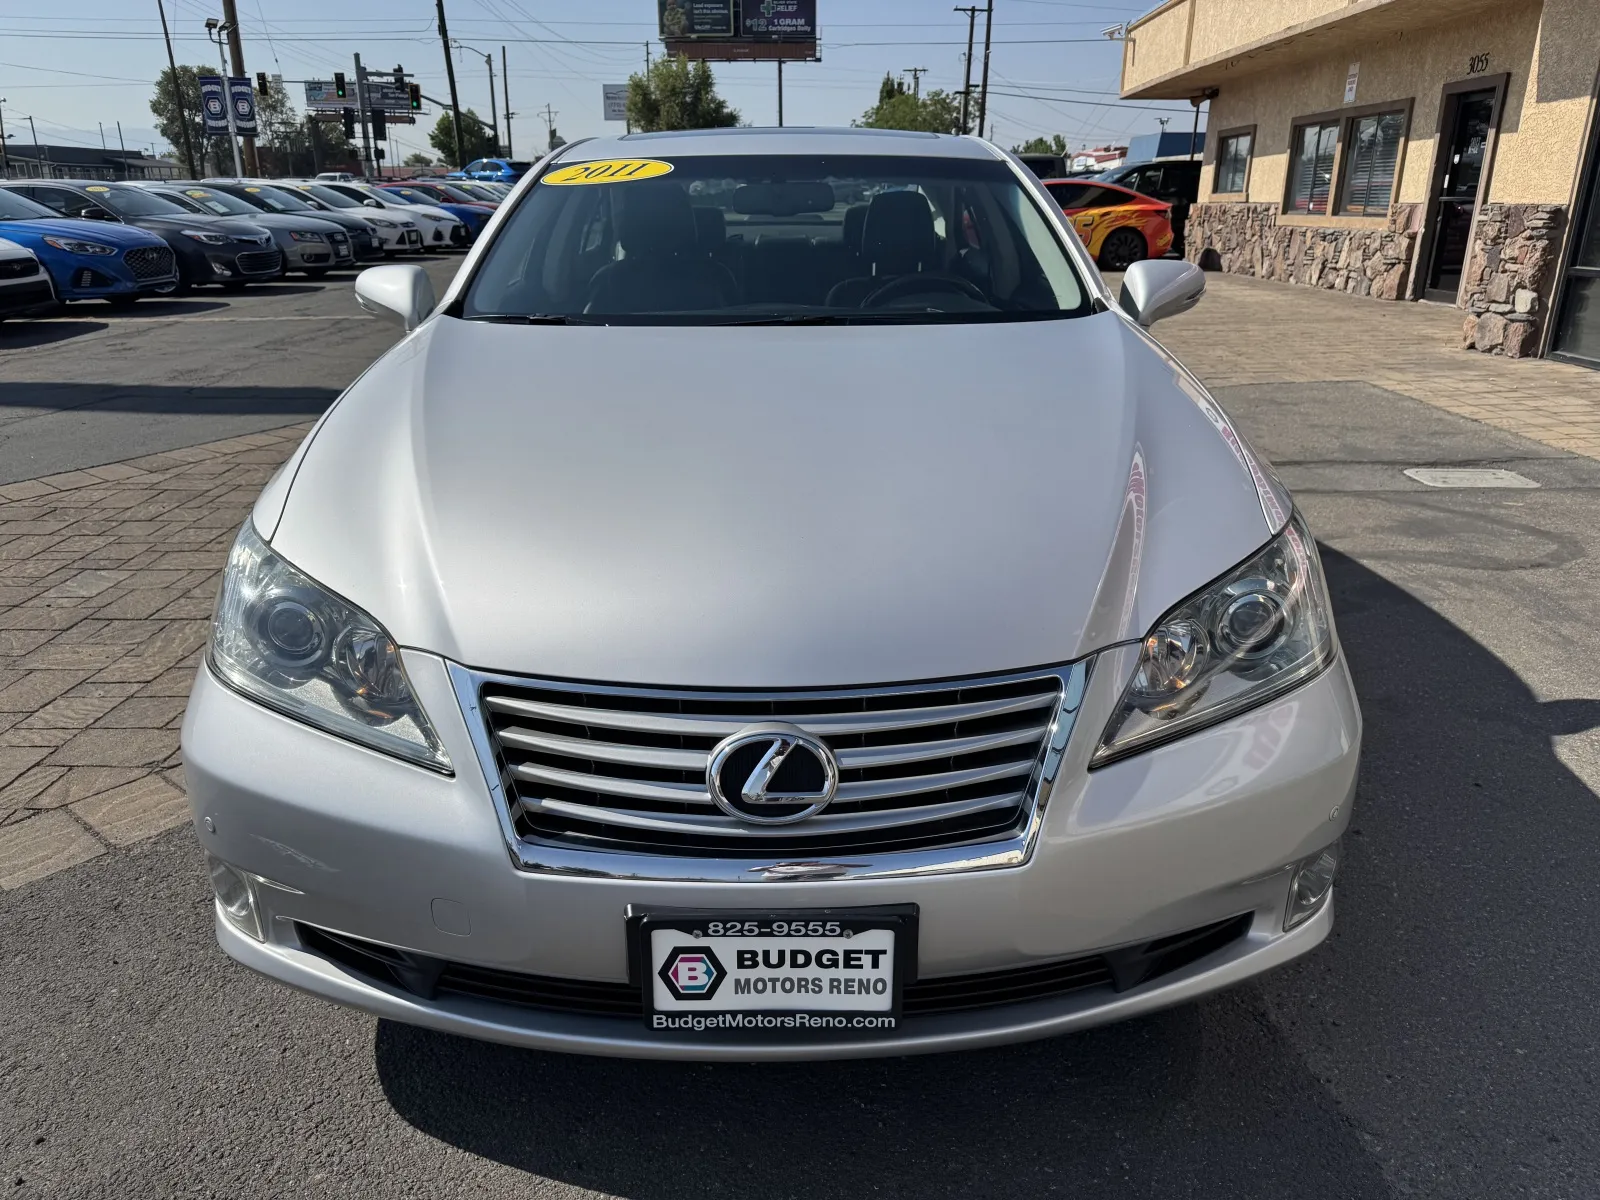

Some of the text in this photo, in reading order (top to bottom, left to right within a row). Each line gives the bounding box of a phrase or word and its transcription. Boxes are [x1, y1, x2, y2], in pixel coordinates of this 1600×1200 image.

[1467, 52, 1490, 75] 3055
[561, 163, 650, 182] 2011
[707, 921, 842, 936] 825-9555
[736, 949, 888, 970] BUDGET
[734, 977, 888, 995] MOTORS RENO
[652, 1013, 896, 1031] BudgetMotorsReno.com
